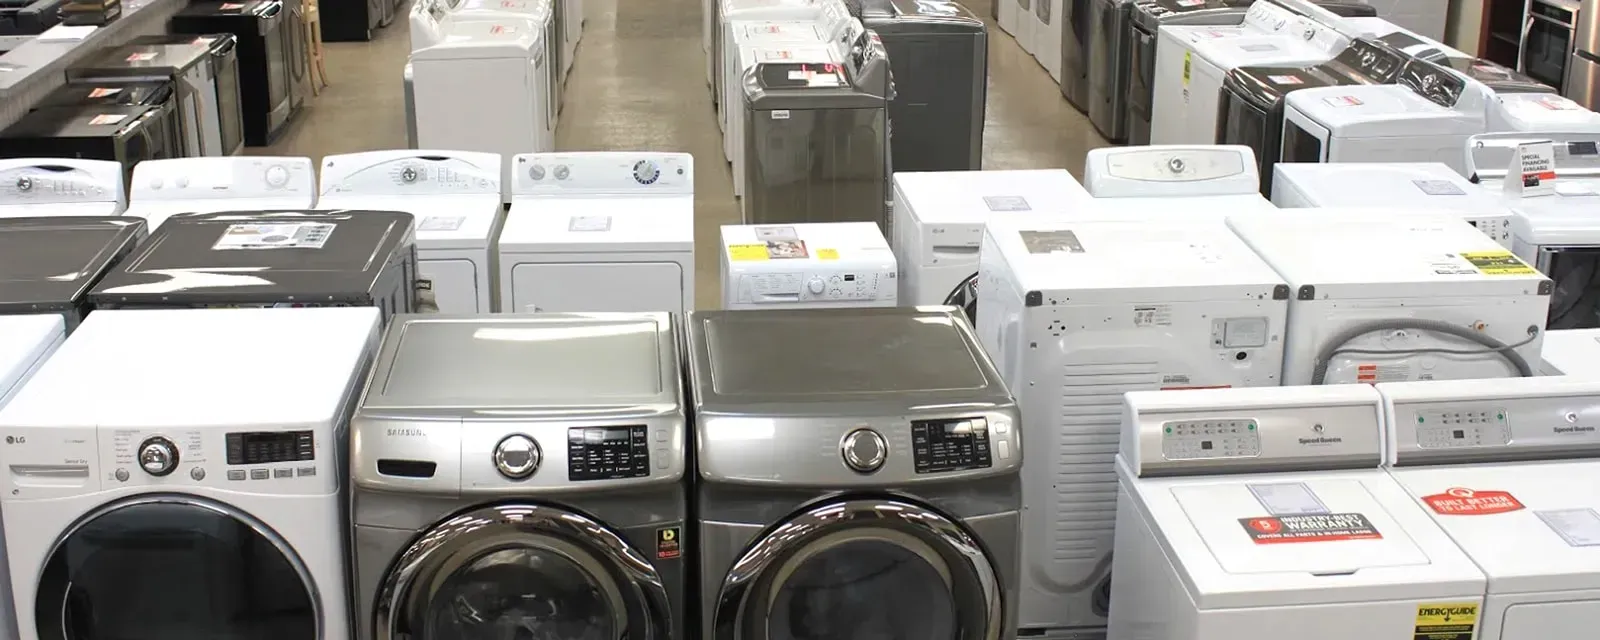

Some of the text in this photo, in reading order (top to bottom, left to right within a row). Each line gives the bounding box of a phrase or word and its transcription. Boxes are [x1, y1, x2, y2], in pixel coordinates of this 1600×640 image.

[15, 436, 26, 444] LG
[1466, 495, 1510, 504] BETTER
[1280, 514, 1360, 523] INDUSTRY-BEST
[1285, 519, 1364, 531] WARRANTY
